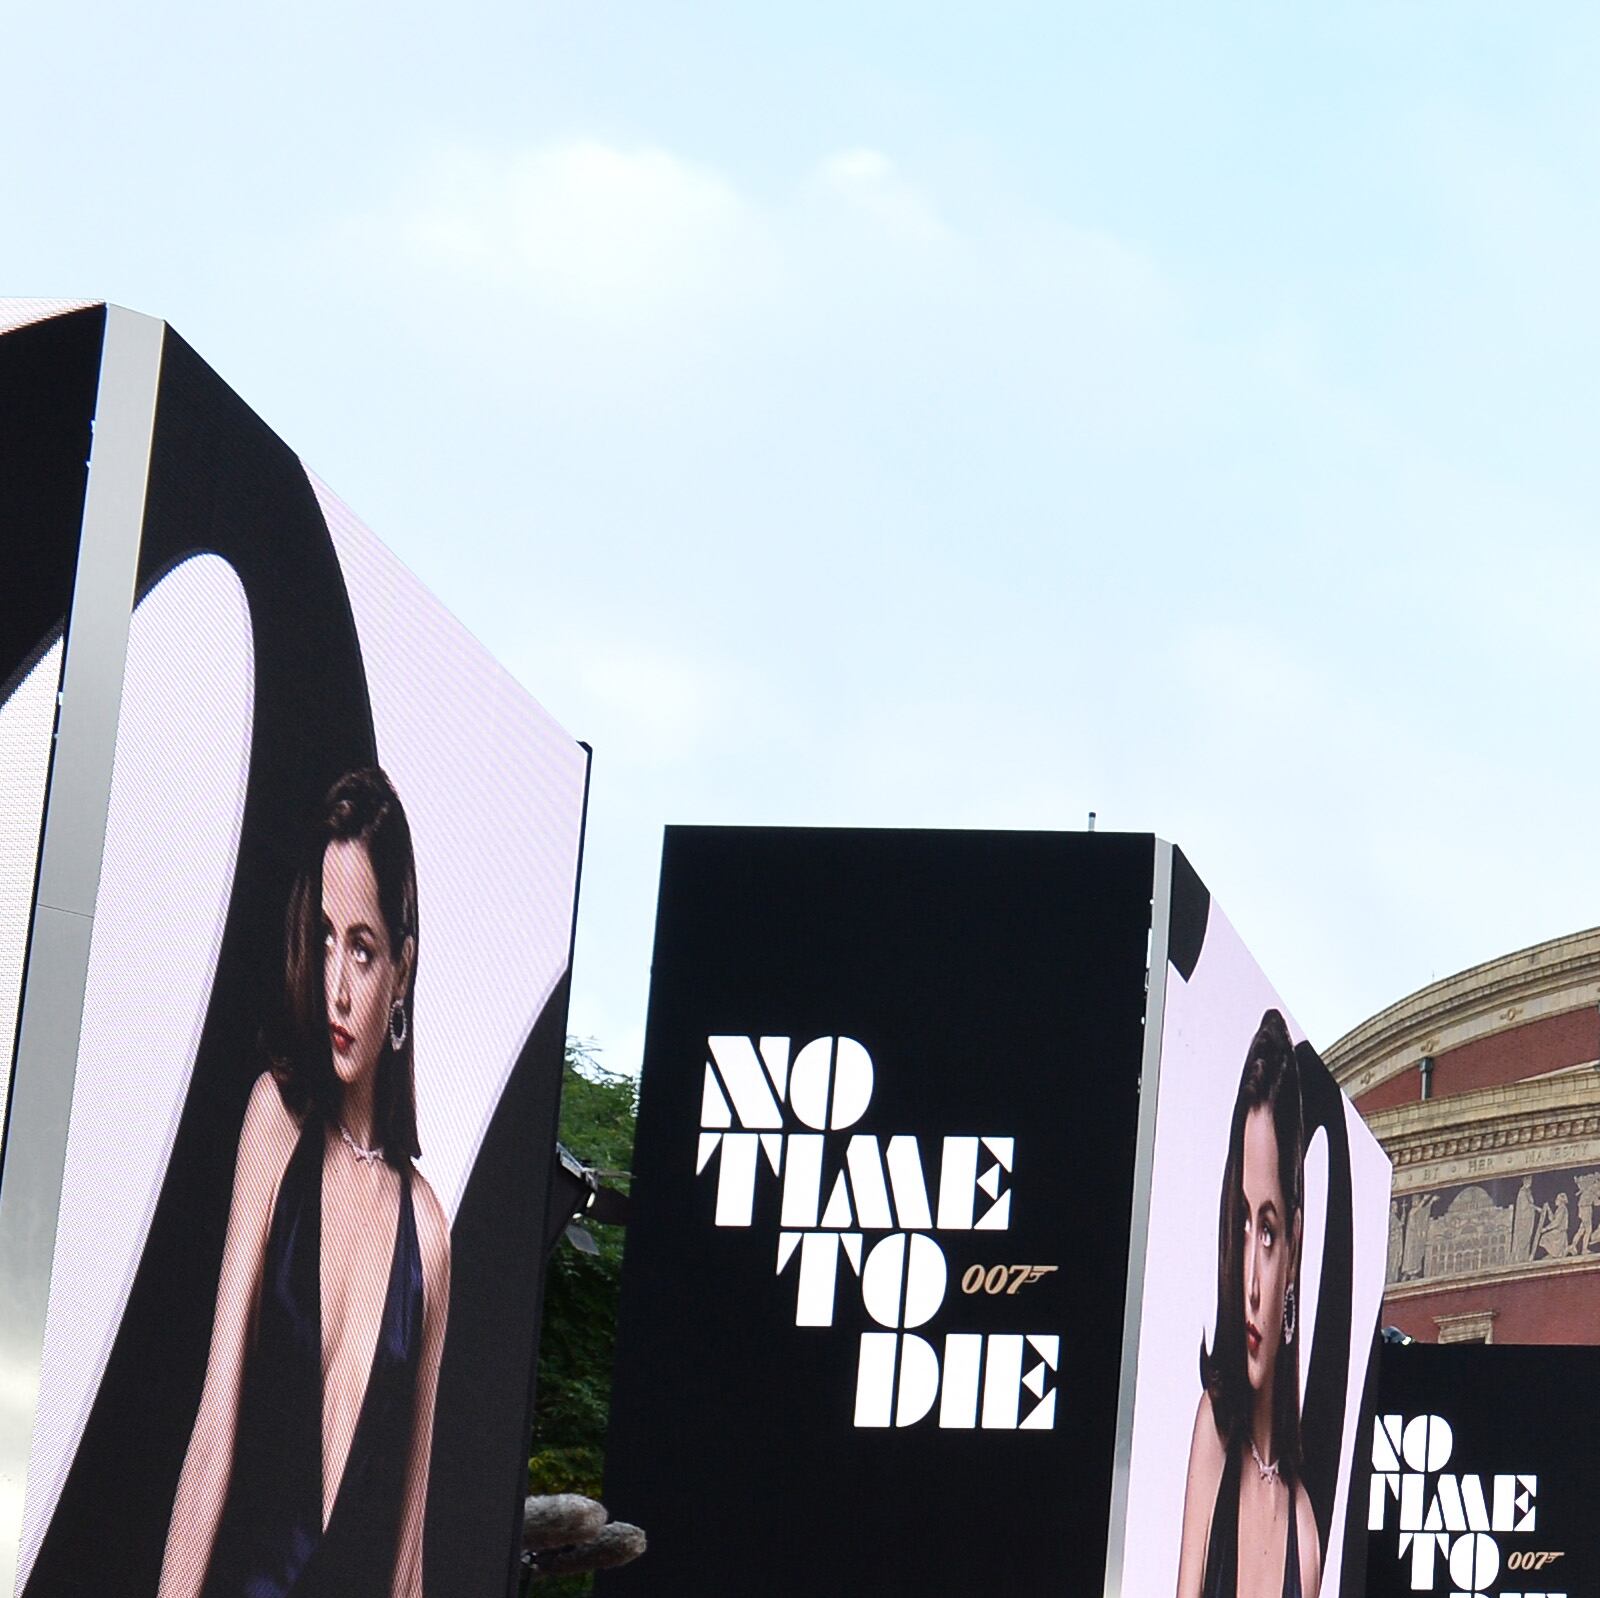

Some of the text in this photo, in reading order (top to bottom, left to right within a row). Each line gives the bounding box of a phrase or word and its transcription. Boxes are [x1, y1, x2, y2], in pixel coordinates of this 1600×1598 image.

[700, 1035, 874, 1131] NO
[696, 1132, 1015, 1231] TIME
[1467, 1159, 1494, 1174] HER
[776, 1231, 947, 1329] TO
[961, 1263, 1047, 1296] 007
[853, 1331, 1061, 1430] DIE
[1398, 1532, 1500, 1591] TO
[1507, 1550, 1560, 1571] 007
